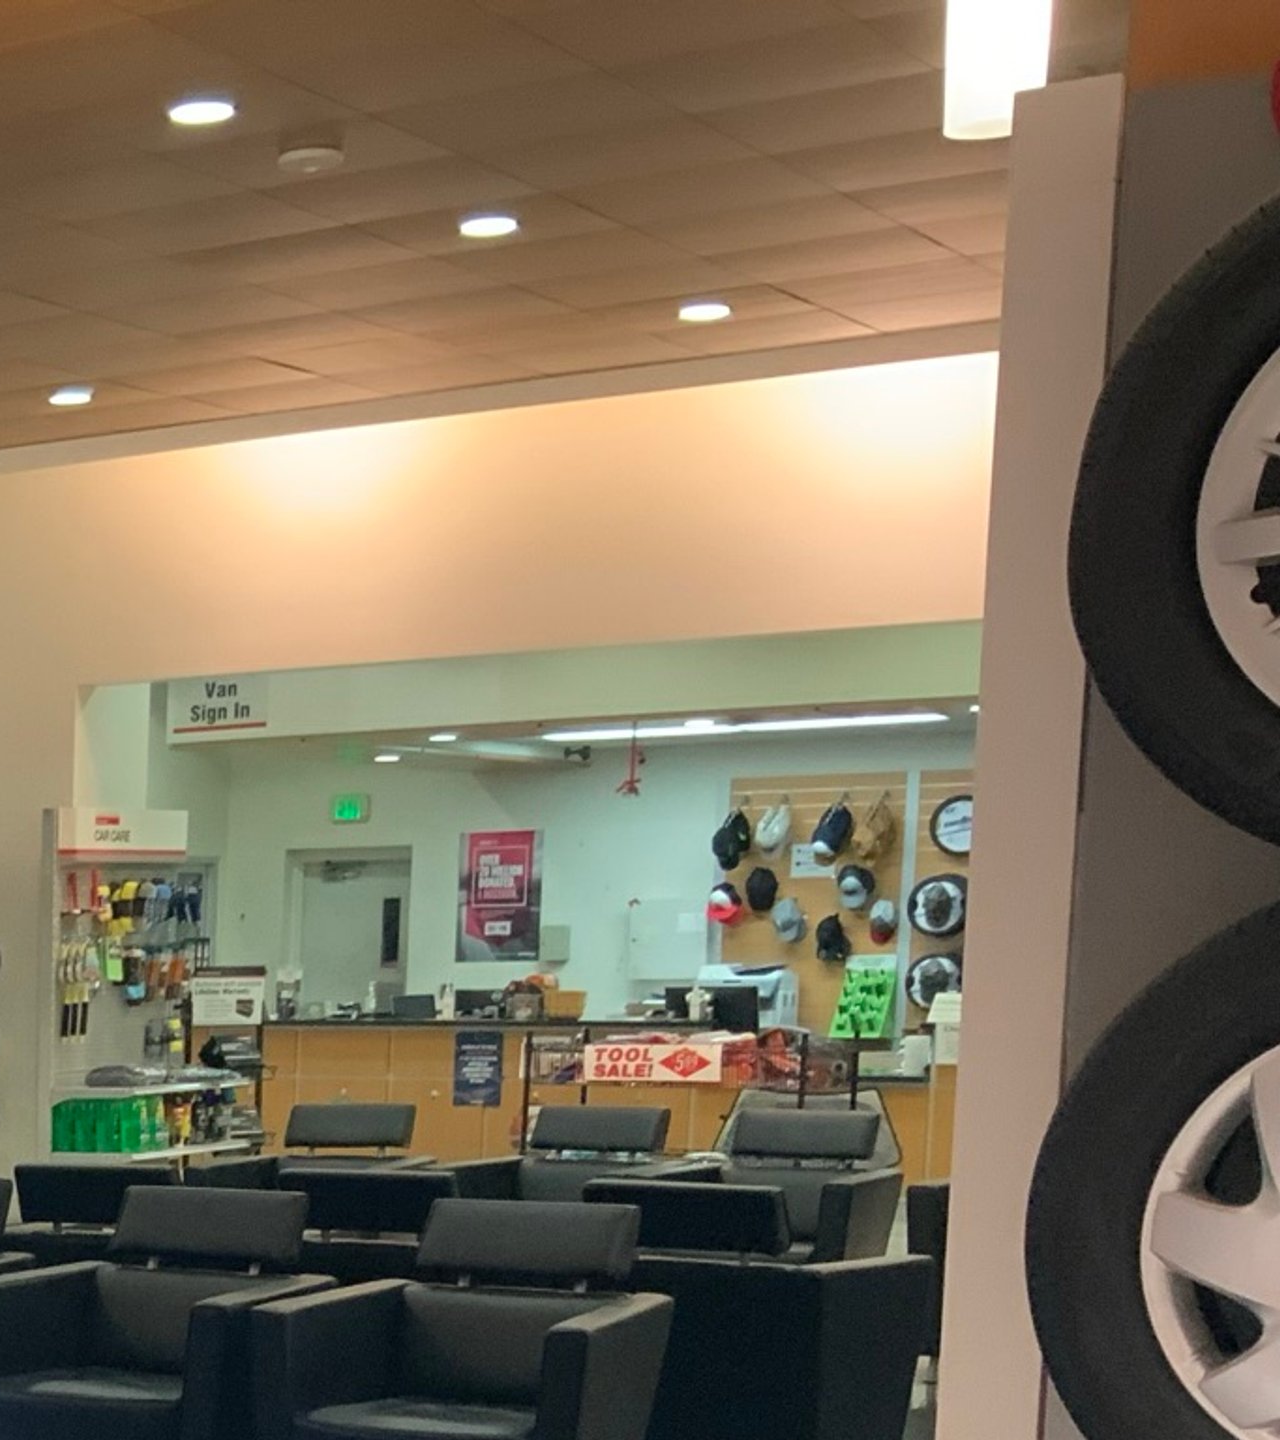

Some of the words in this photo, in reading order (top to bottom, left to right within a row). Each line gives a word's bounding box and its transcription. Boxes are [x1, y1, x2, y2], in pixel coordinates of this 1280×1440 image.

[204, 681, 238, 699] Van
[189, 703, 228, 724] Sign
[233, 702, 251, 719] In
[94, 829, 110, 843] CAR
[111, 830, 131, 843] CARE
[594, 1047, 654, 1062] TOOL
[593, 1063, 654, 1078] SALE!
